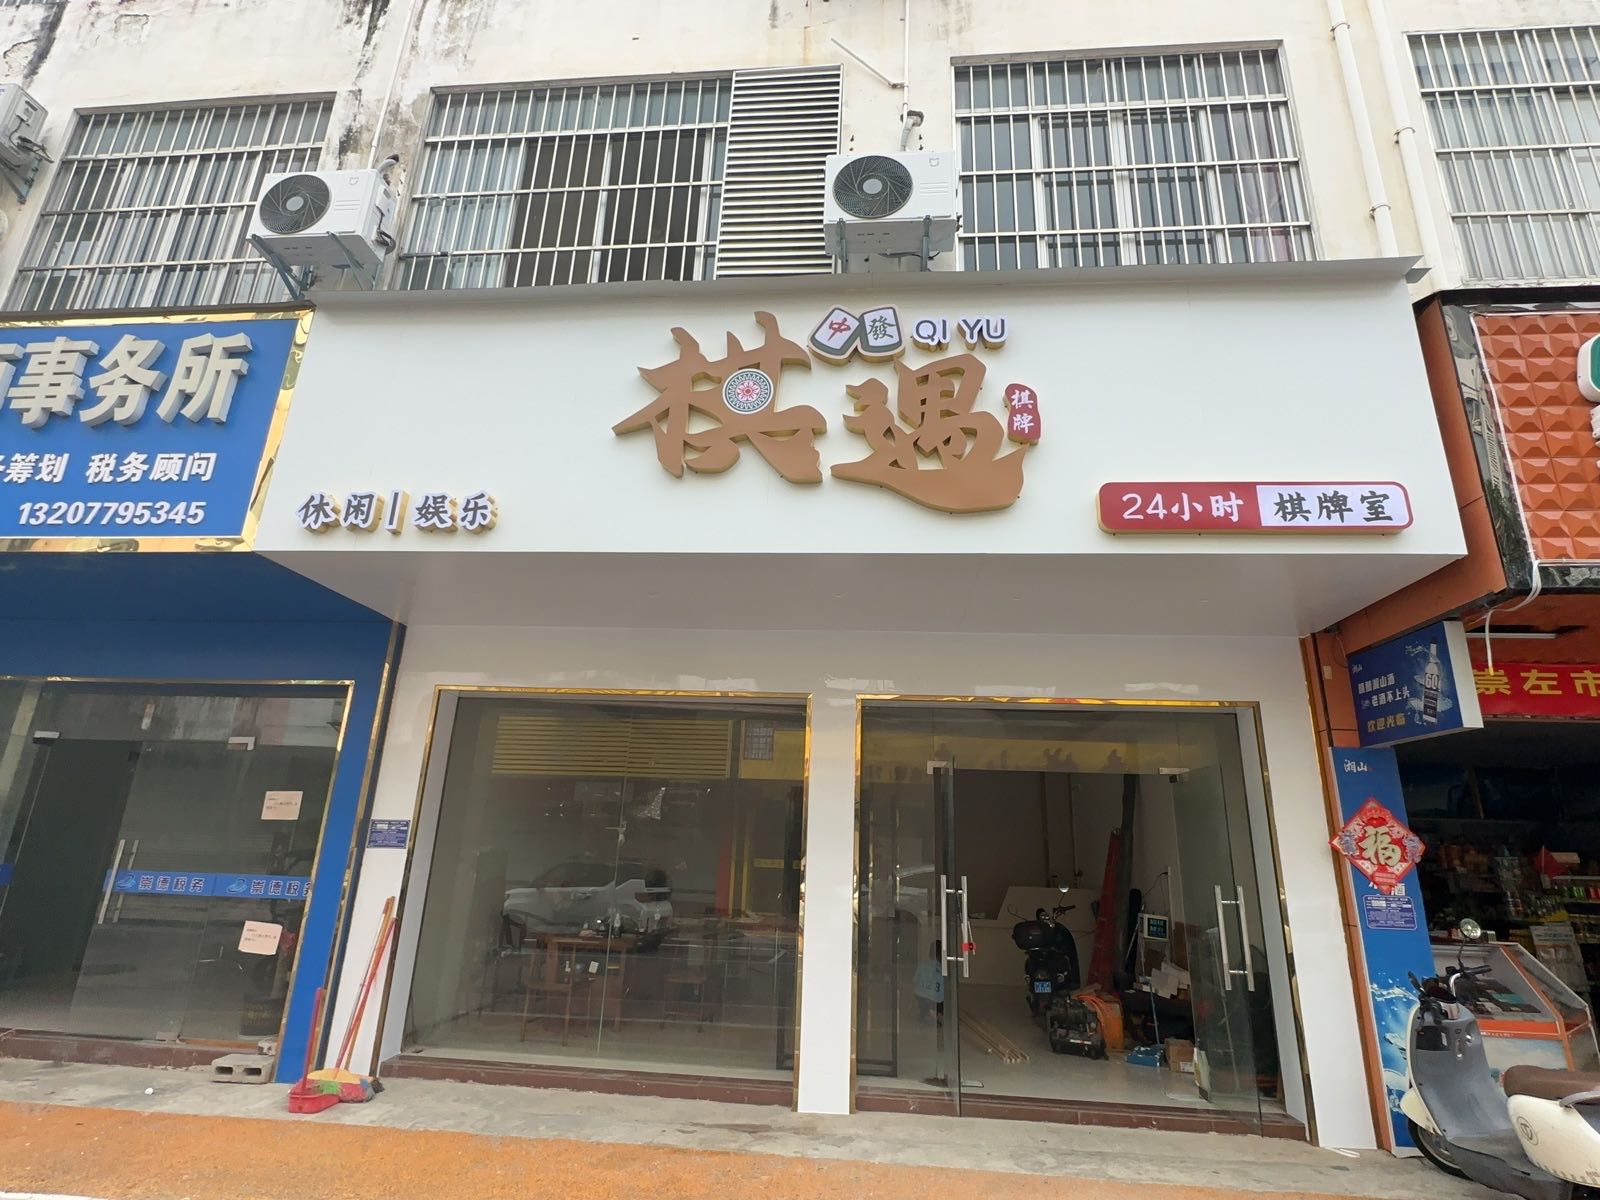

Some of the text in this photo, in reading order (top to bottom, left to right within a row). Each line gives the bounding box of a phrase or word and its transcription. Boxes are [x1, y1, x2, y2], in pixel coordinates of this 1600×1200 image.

[827, 315, 896, 342] 中 發
[914, 317, 1005, 341] QI YU
[611, 310, 1029, 512] 棋遇
[1010, 388, 1035, 435] 棋牌
[0, 451, 217, 484] 筹划 税务顾问
[18, 500, 207, 526] 13207795345
[1121, 490, 1394, 523] 24小时 棋牌室
[1473, 668, 1600, 697] 崇左市
[1358, 824, 1402, 868] 福
[139, 875, 204, 892] 崇德税务
